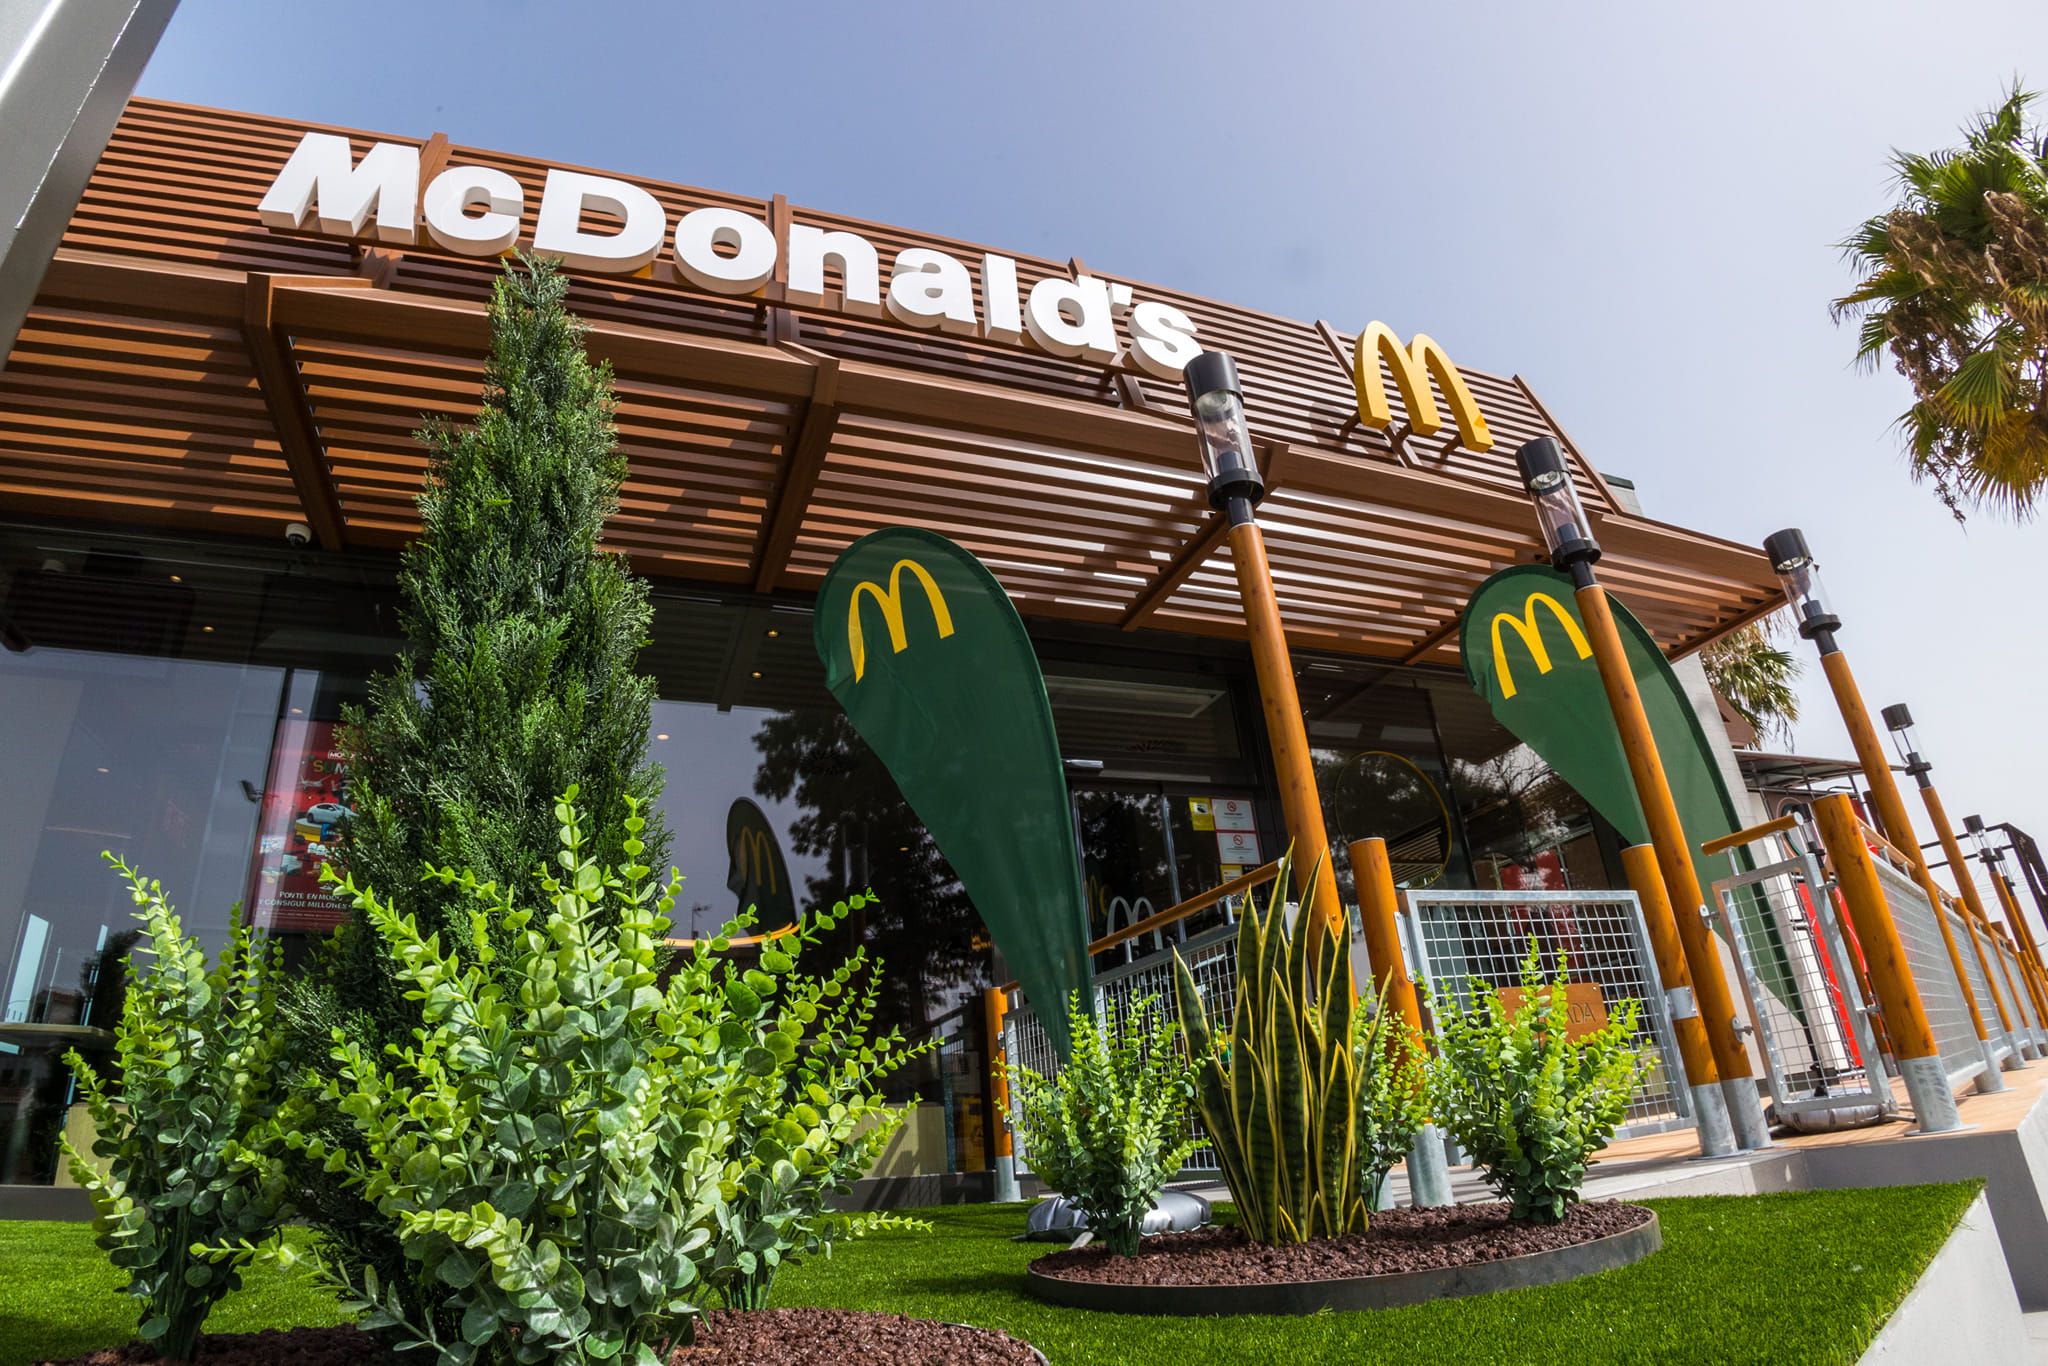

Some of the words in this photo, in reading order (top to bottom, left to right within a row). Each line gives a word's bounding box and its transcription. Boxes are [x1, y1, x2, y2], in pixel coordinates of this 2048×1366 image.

[257, 131, 1202, 381] McDonald's
[279, 890, 304, 900] PONTE
[306, 892, 318, 901] EN
[265, 898, 306, 908] CONSIGUE
